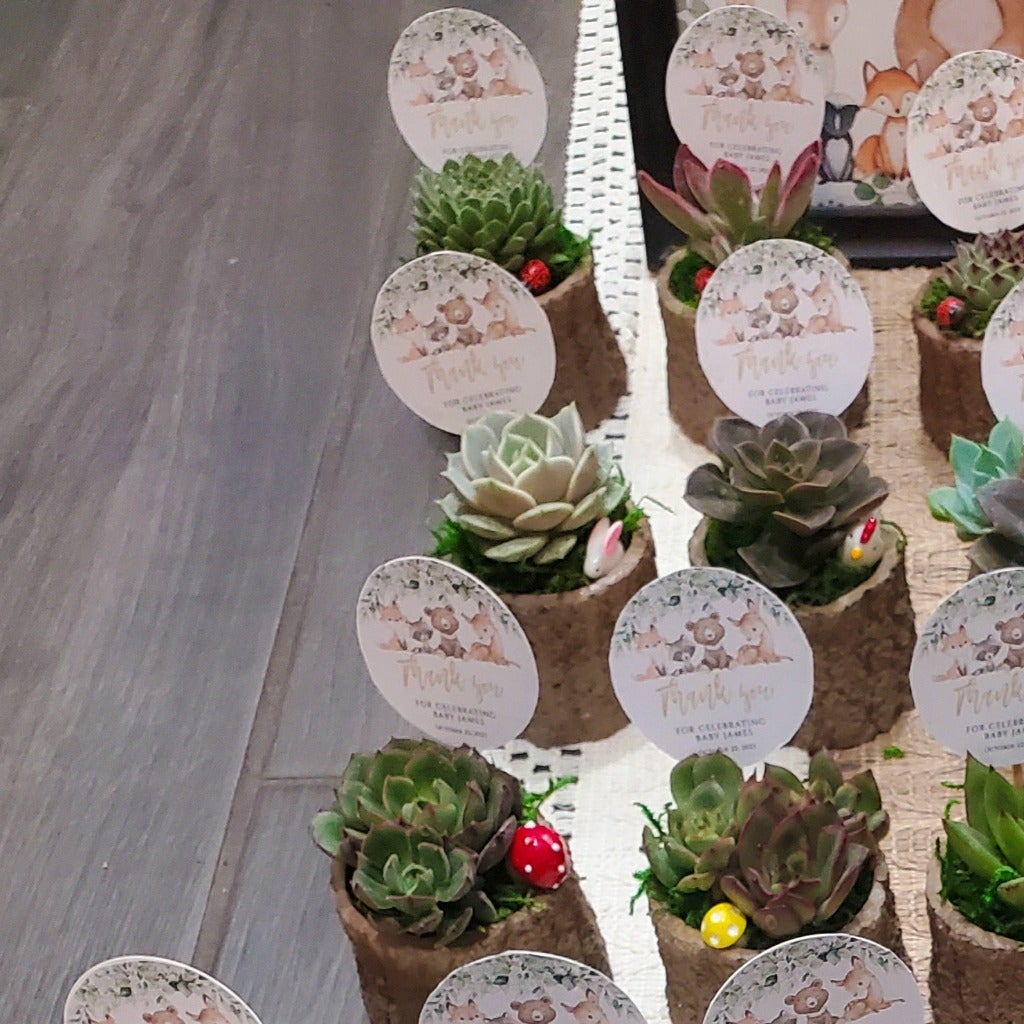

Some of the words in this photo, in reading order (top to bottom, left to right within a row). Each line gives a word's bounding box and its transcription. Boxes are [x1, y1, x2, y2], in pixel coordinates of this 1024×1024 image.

[397, 656, 465, 692] Thank
[472, 674, 504, 703] you
[655, 672, 731, 718] Thank
[739, 681, 775, 713] you
[953, 671, 1024, 716] Thank
